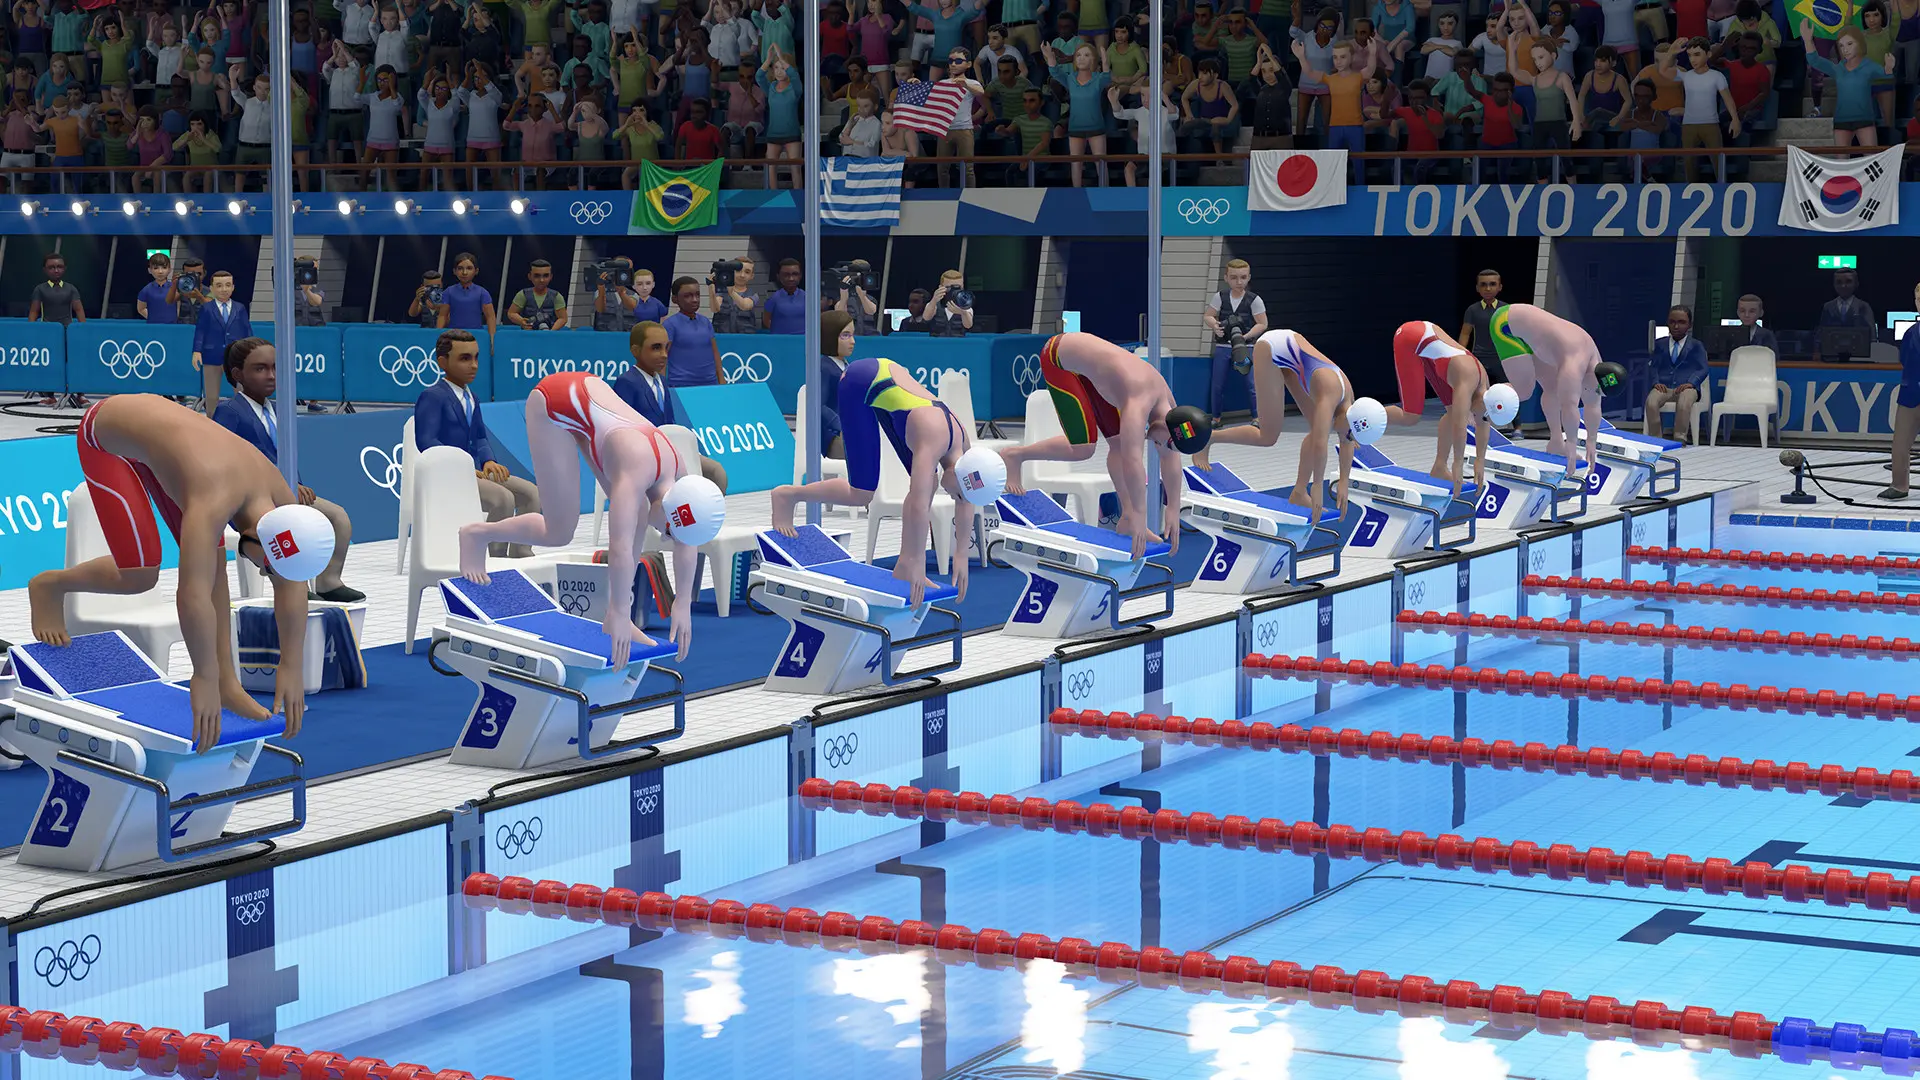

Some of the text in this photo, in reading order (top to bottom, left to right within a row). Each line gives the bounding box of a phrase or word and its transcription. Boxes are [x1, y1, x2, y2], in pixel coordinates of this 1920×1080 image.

[1367, 183, 1757, 237] TOKYO 2020
[10, 347, 50, 366] 2020
[295, 353, 326, 373] 020
[510, 358, 576, 379] TOKYO
[721, 422, 775, 453] 2020
[962, 475, 972, 491] USA
[1588, 472, 1601, 490] 9
[1485, 494, 1498, 513] 8
[1529, 494, 1546, 518] 8
[670, 509, 682, 528] TUR
[1365, 521, 1379, 540] 7
[1411, 519, 1433, 546] 7
[268, 538, 284, 561] TUN
[1213, 552, 1228, 573] 6
[1269, 550, 1290, 579] 6
[570, 581, 596, 593] 2020
[1028, 591, 1043, 615] 5
[1090, 589, 1112, 621] 5
[790, 641, 806, 667] 4
[480, 707, 499, 737] 3
[50, 797, 70, 833] 2
[230, 887, 270, 906] TOKYO 2020
